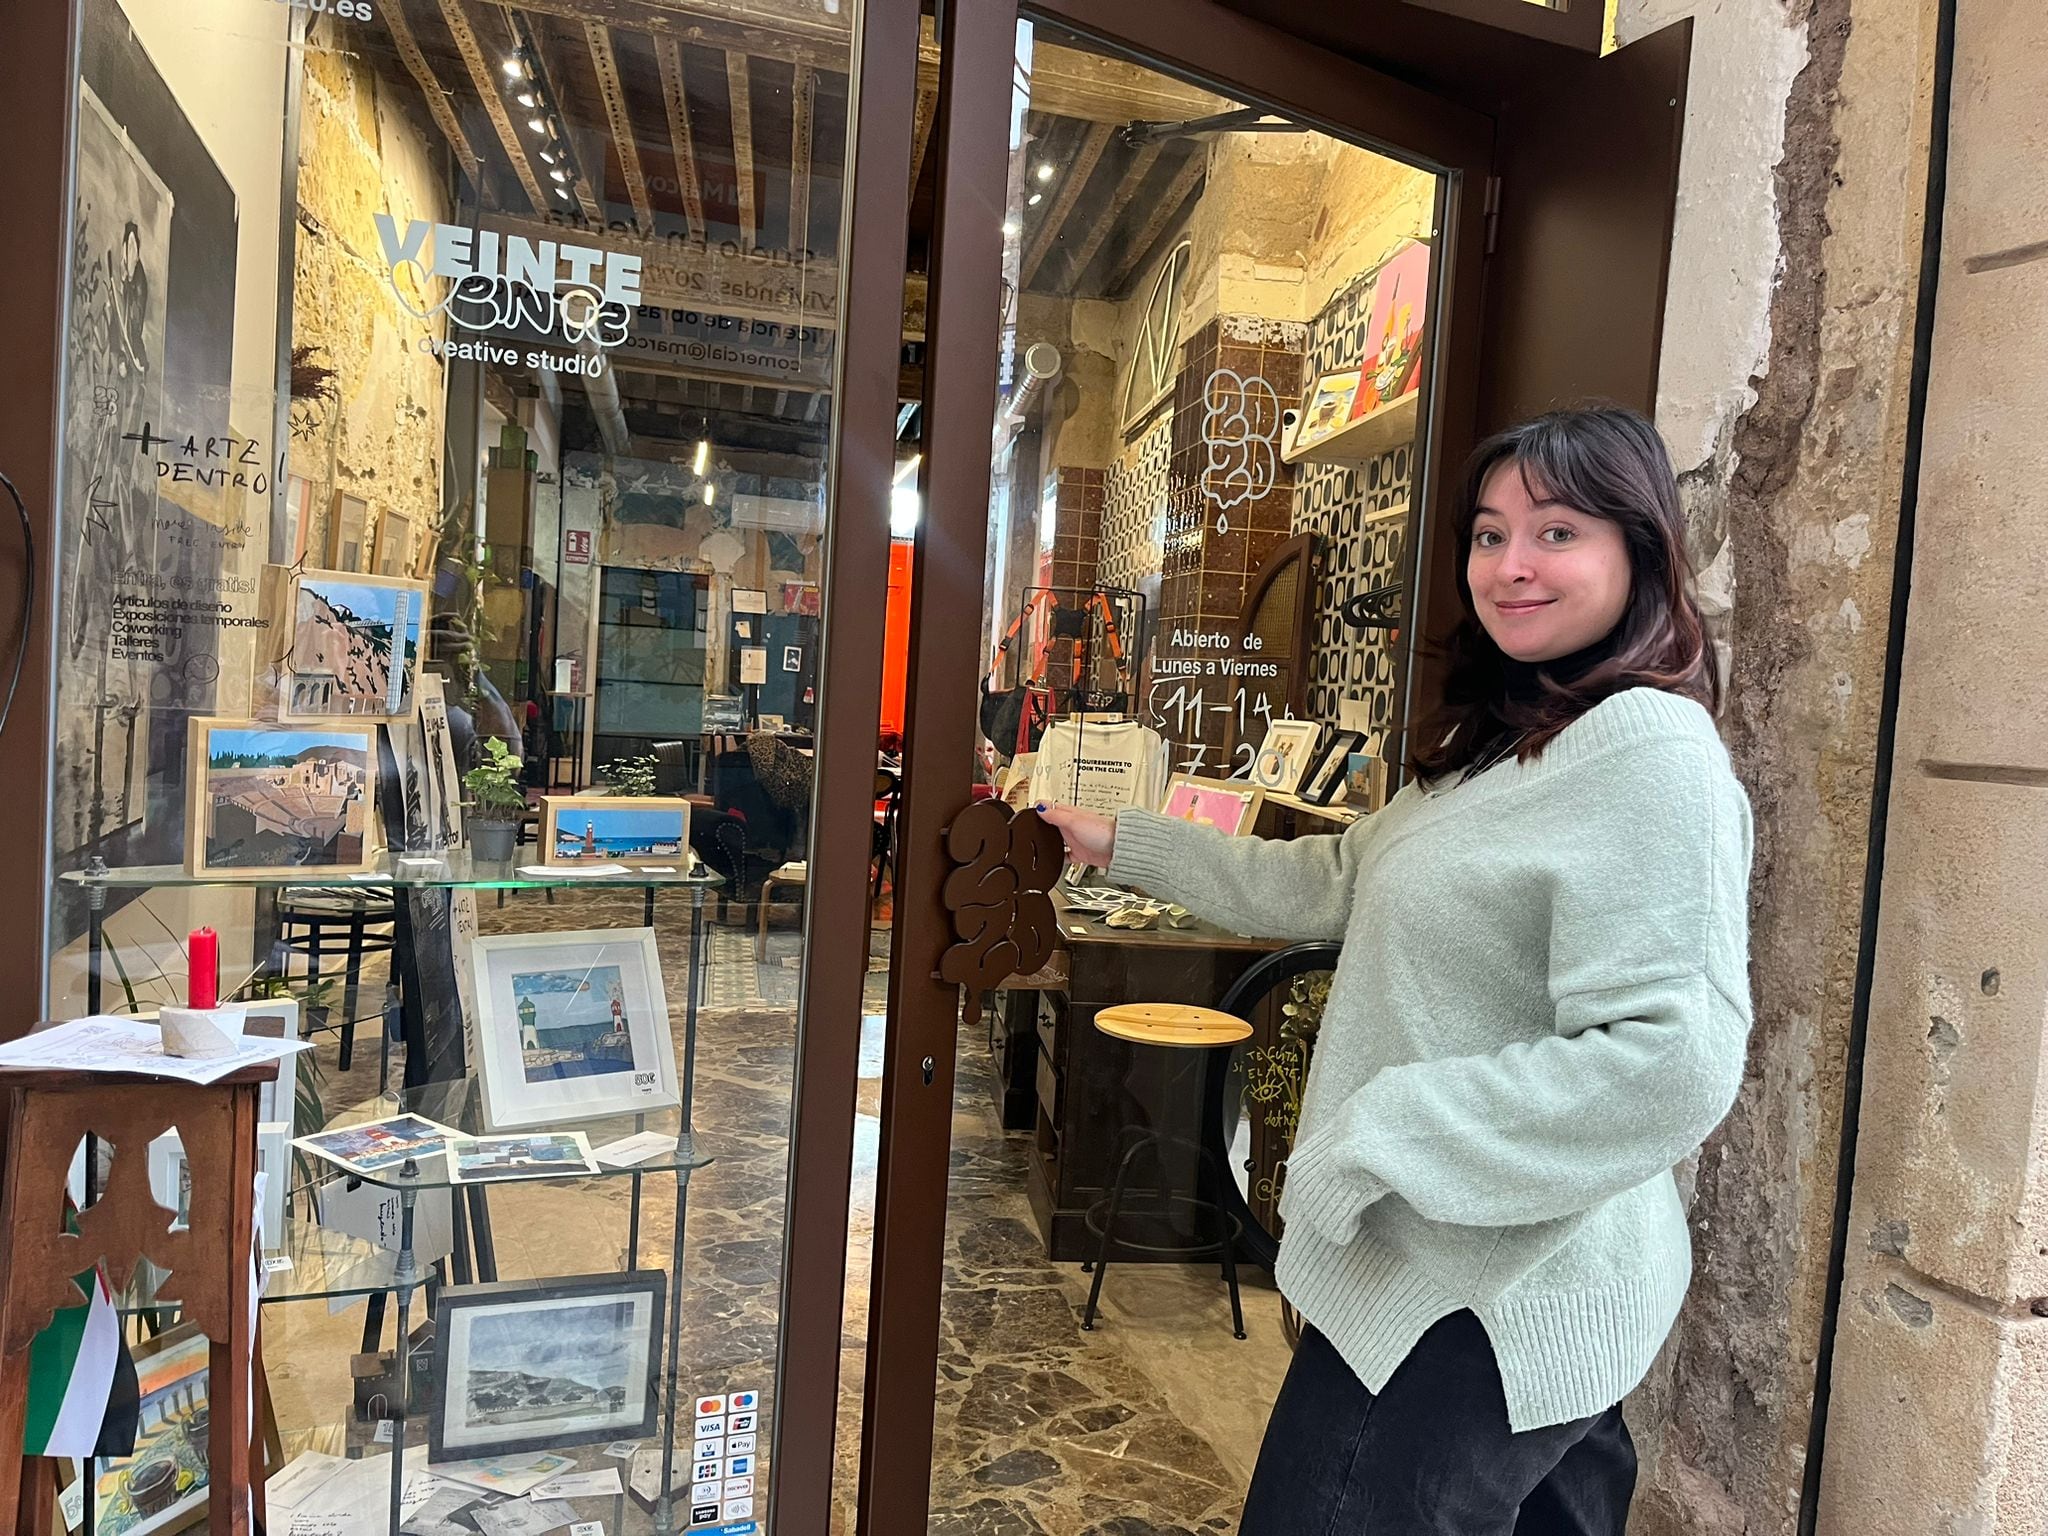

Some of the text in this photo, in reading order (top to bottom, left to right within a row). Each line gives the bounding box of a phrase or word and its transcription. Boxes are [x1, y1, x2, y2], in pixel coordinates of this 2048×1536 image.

[373, 213, 641, 306] VEINTE
[419, 338, 519, 366] creative
[181, 435, 260, 465] ARTE
[170, 576, 193, 591] es
[171, 598, 188, 610] de
[190, 600, 232, 613] diseño
[200, 614, 269, 628] temporales
[112, 621, 182, 639] Coworking
[112, 635, 160, 648] Talleres
[1171, 629, 1263, 650] Abierto de
[112, 648, 164, 662] Eventos
[1152, 655, 1278, 677] Lunes a Viernes
[701, 1423, 721, 1433] VISA
[737, 1441, 751, 1449] Pay
